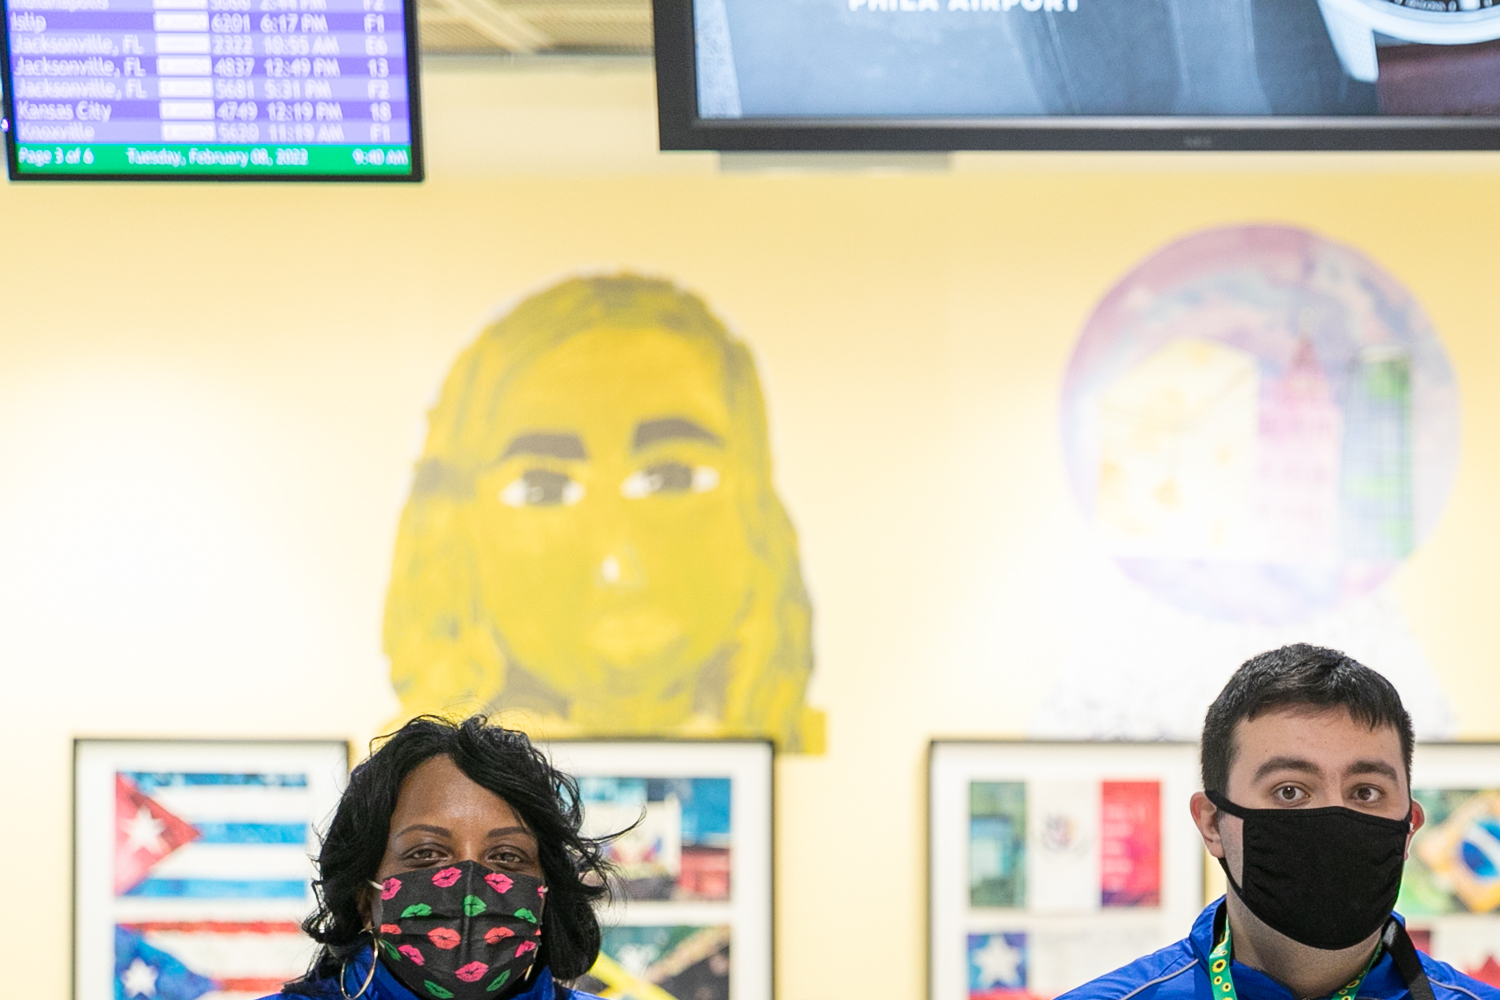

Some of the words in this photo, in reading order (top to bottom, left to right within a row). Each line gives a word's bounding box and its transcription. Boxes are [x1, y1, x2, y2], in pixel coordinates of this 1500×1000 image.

[947, 0, 1079, 12] AIRPORT
[10, 12, 47, 34] Islip
[300, 13, 328, 33] PM
[364, 13, 385, 33] F1
[11, 34, 119, 57] Jacksonville,
[122, 35, 145, 54] FL
[311, 35, 340, 55] AM
[13, 56, 121, 79] Jacksonville,
[123, 57, 147, 77] FL
[312, 57, 341, 78] PM
[15, 78, 123, 101] Jacksonville,
[125, 79, 148, 98] FL
[304, 79, 332, 100] PM
[16, 100, 74, 120] Kansas
[75, 100, 112, 123] City
[315, 101, 343, 122] PM
[18, 122, 95, 142] Knoxville
[317, 123, 345, 143] AM
[369, 123, 391, 143] F1
[18, 147, 52, 167] Page
[54, 147, 64, 164] 3
[65, 147, 81, 164] of
[83, 148, 95, 164] 6
[126, 147, 186, 168] Tuesday,
[189, 147, 249, 168] February
[275, 148, 309, 165] 2022
[386, 149, 409, 165] AM
